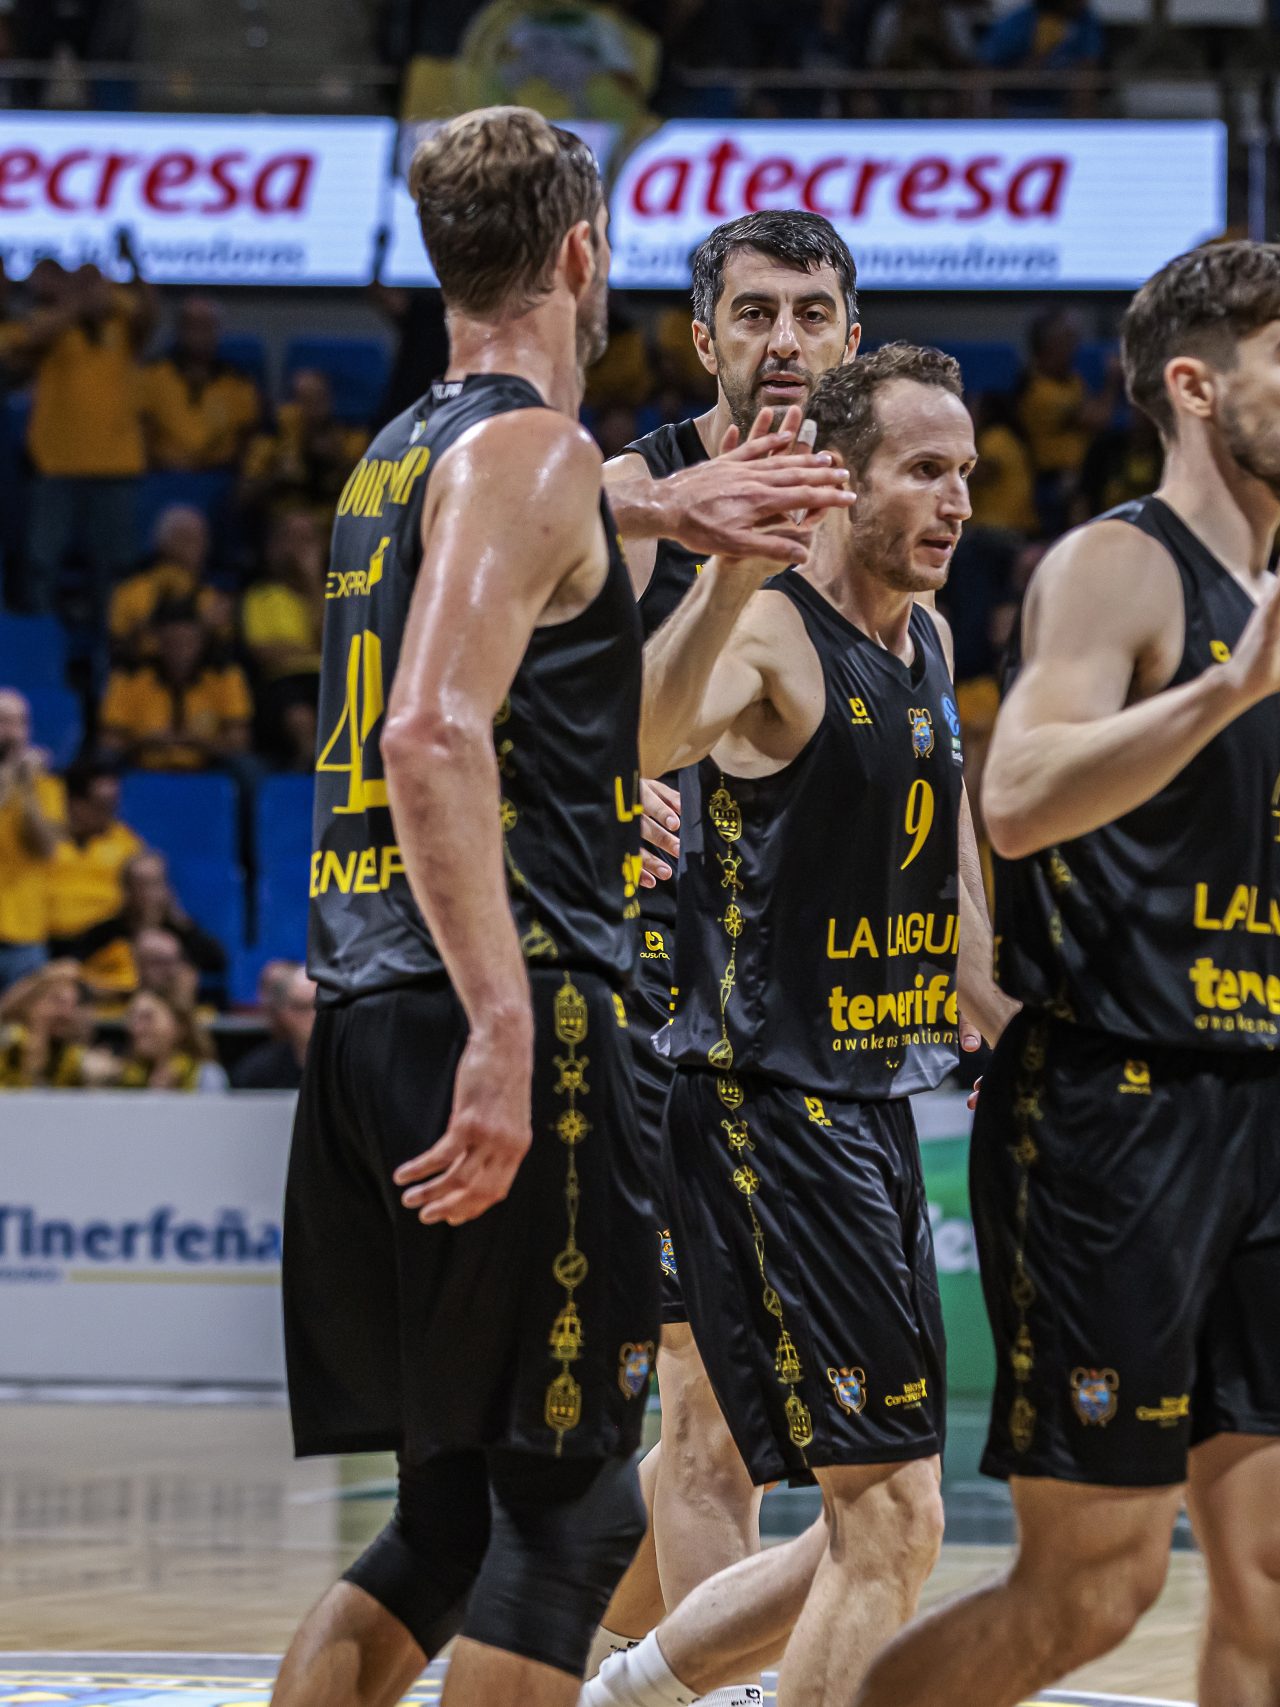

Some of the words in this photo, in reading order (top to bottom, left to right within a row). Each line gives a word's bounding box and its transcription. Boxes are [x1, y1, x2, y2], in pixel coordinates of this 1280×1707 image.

[631, 138, 1069, 220] atecresa
[900, 778, 934, 871] 9
[826, 916, 880, 960] LA
[886, 912, 960, 957] LAGU
[832, 1033, 898, 1052] awakens
